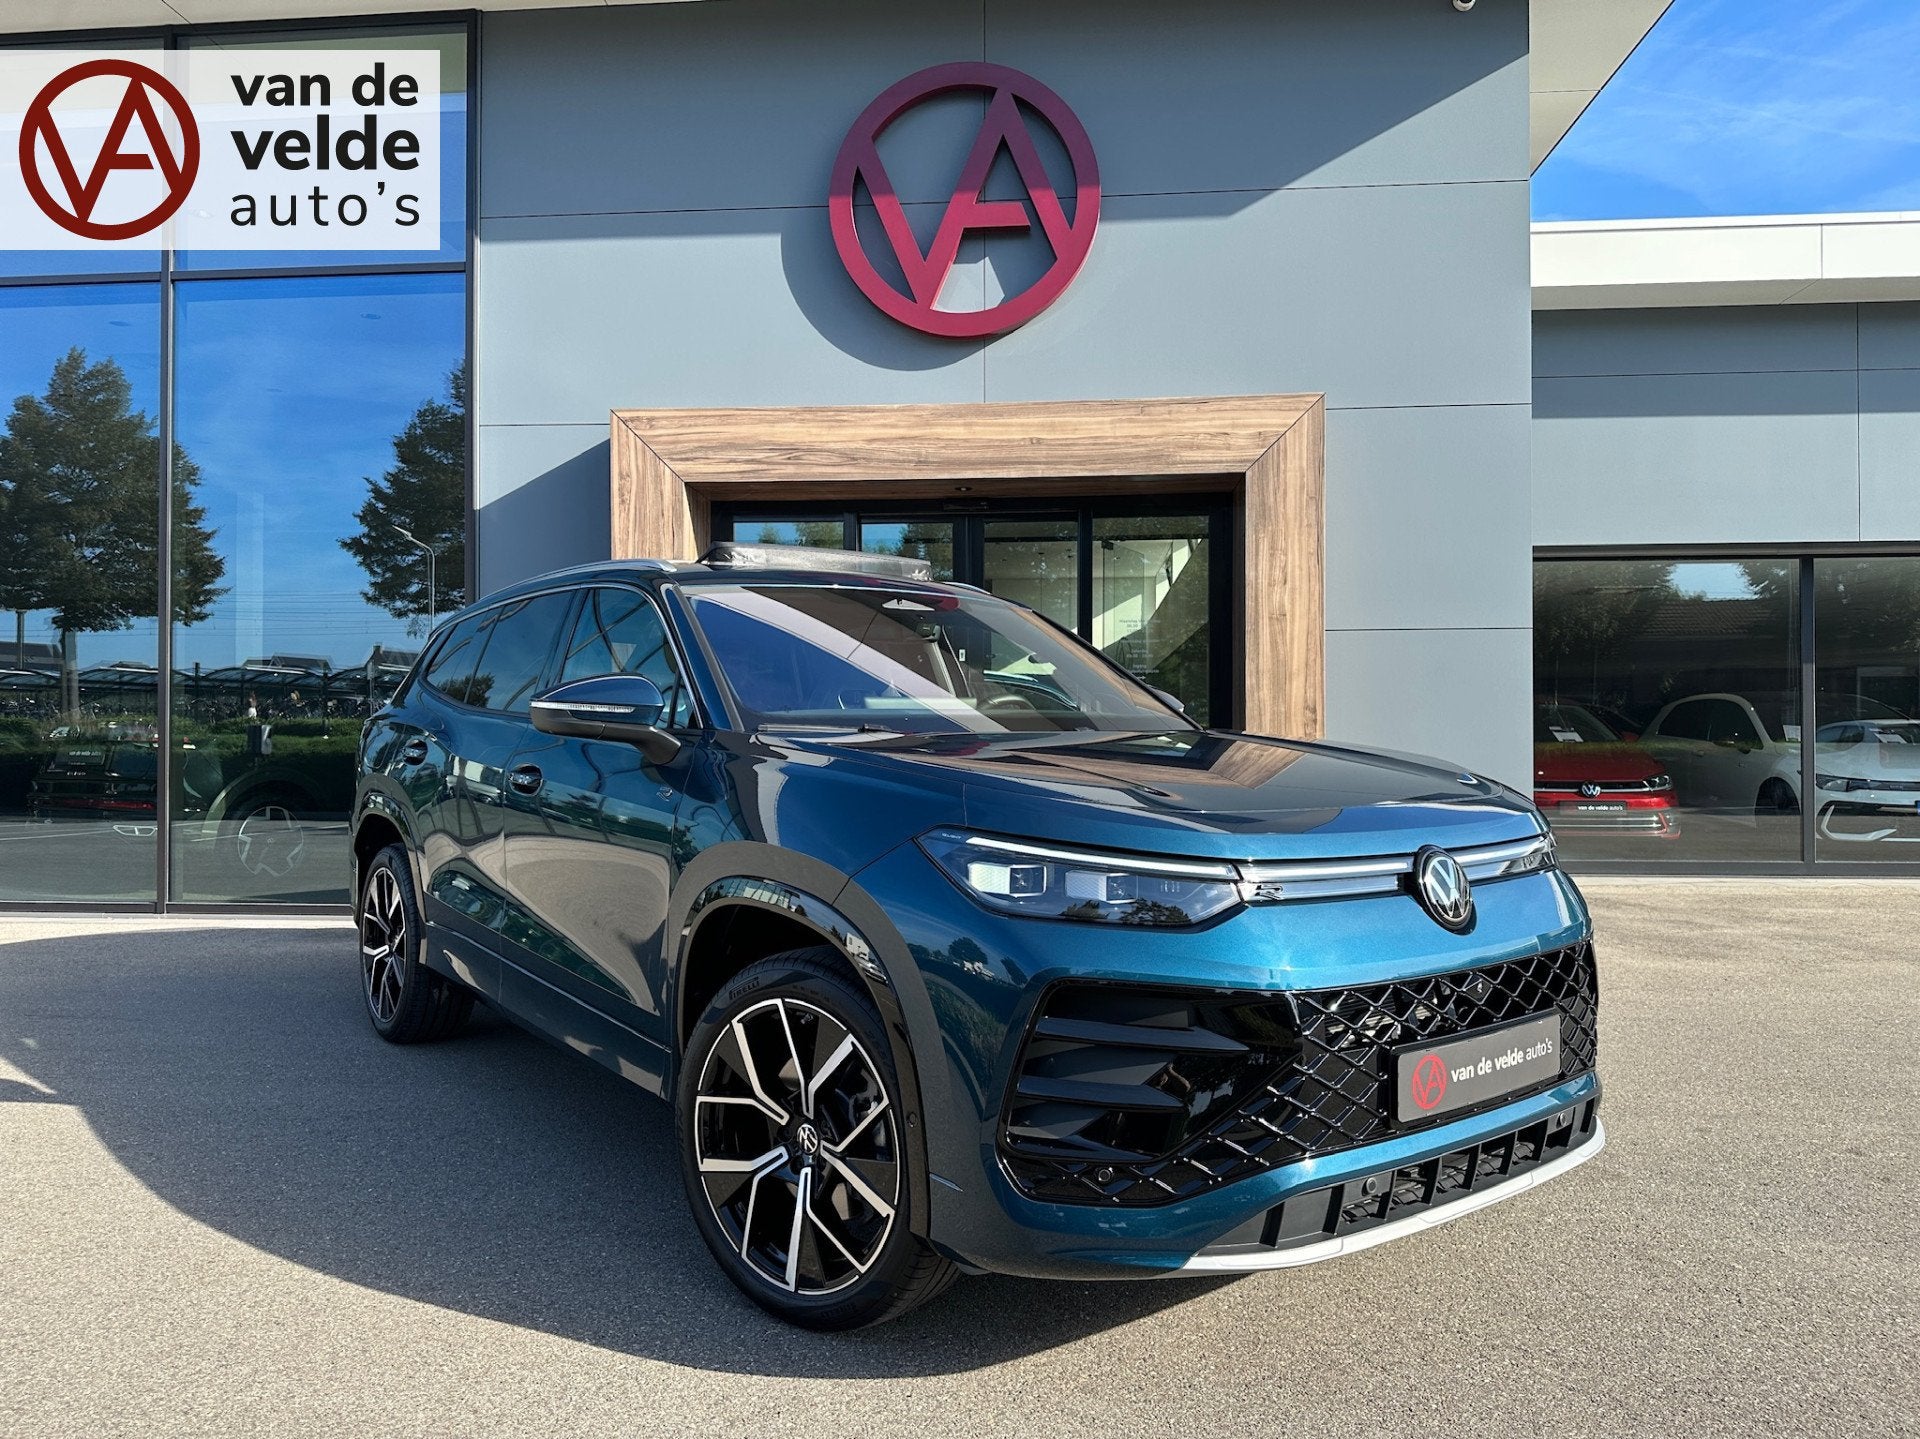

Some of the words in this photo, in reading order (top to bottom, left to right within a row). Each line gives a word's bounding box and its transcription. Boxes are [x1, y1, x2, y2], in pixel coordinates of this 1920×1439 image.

[1451, 1065, 1475, 1083] van
[1477, 1057, 1492, 1074] de
[1495, 1049, 1524, 1071] velde
[1525, 1038, 1553, 1060] auto's
